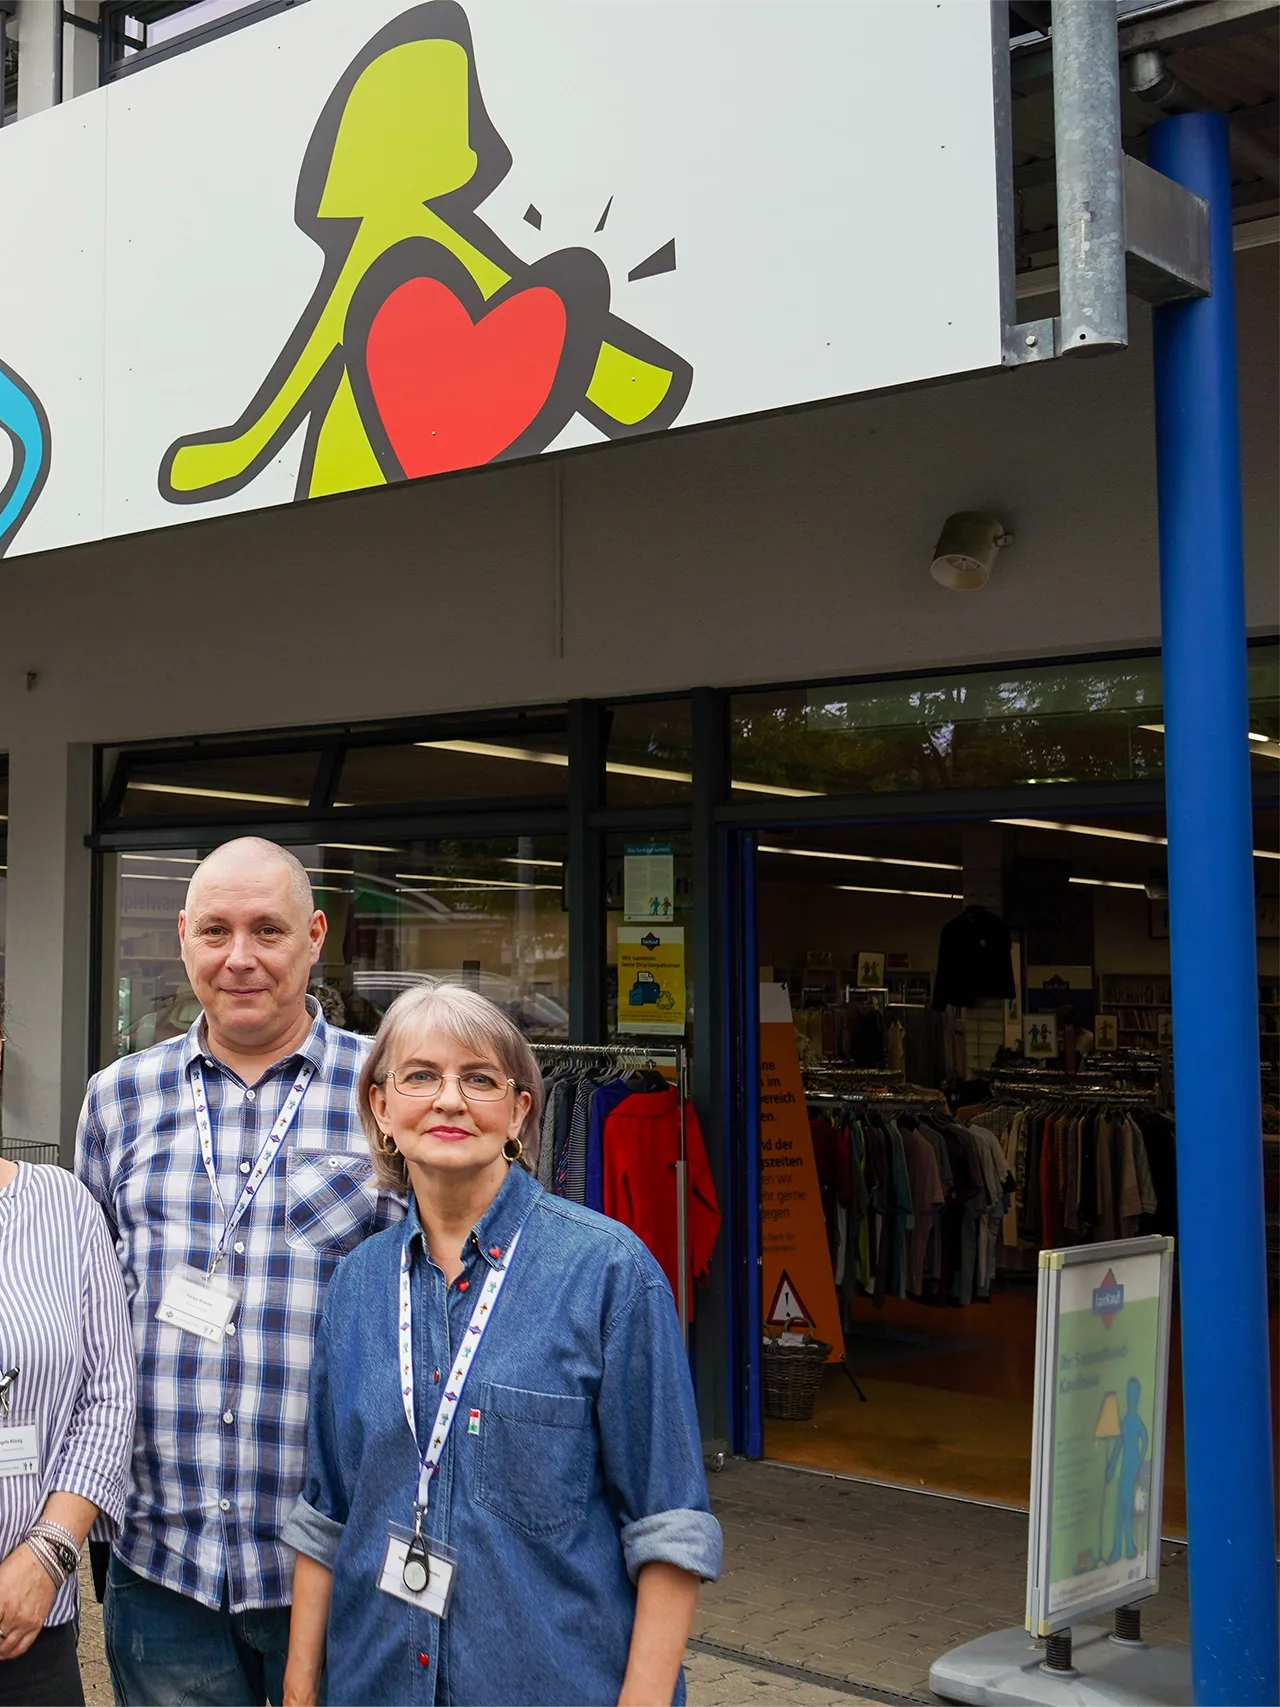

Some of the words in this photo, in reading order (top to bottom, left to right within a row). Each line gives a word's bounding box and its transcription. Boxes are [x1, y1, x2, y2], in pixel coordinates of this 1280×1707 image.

[767, 1076, 781, 1087] im
[760, 1112, 778, 1122] en.
[775, 1137, 793, 1150] der
[761, 1175, 774, 1184] en
[776, 1172, 792, 1184] wir
[777, 1190, 806, 1204] gerne
